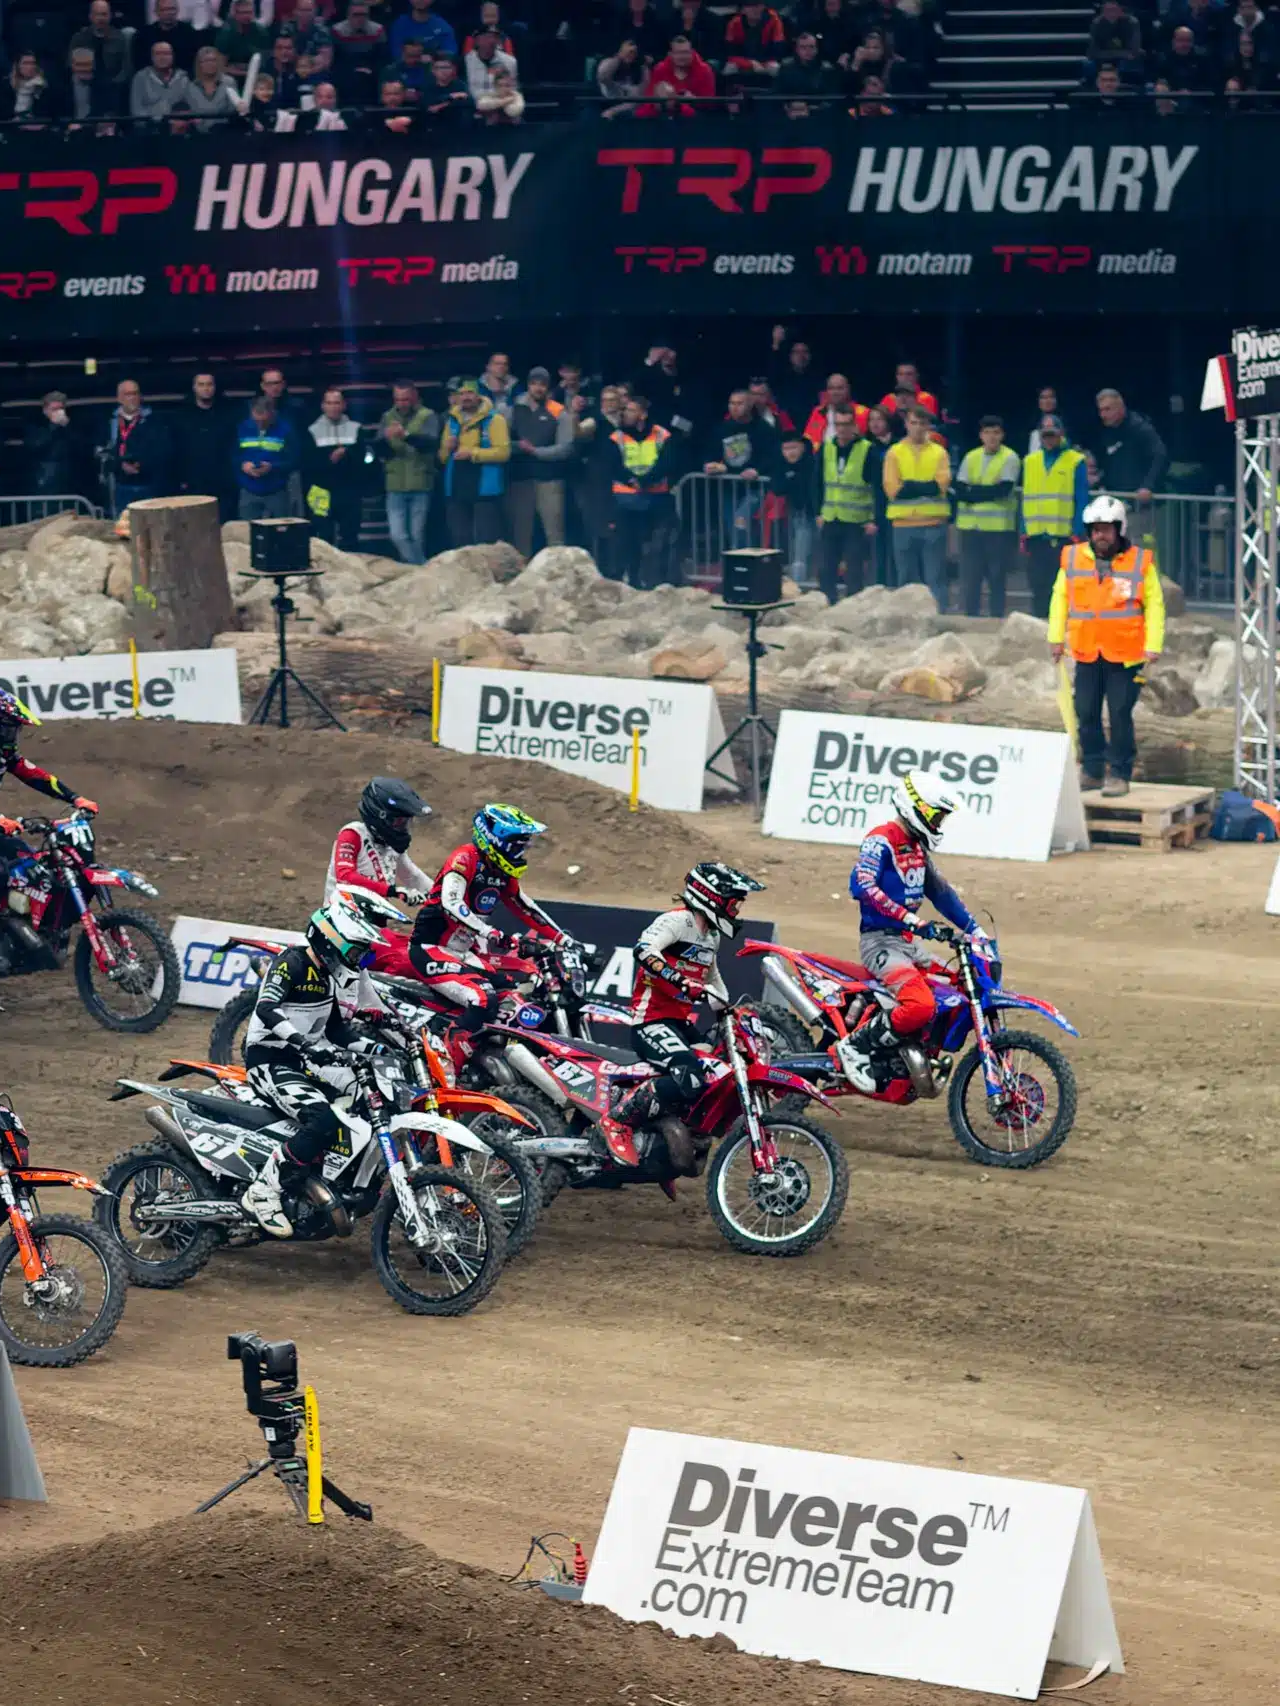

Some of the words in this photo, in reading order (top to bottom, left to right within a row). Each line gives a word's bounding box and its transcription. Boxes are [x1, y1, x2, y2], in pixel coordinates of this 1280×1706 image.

[194, 152, 534, 231] HUNGARY
[596, 147, 832, 214] TRP
[848, 145, 1198, 213] HUNGARY
[338, 257, 435, 287] TRP
[440, 255, 519, 284] media
[615, 246, 706, 274] TRP
[714, 252, 795, 276] events
[877, 251, 971, 276] motam
[992, 246, 1091, 274] TRP
[1097, 248, 1176, 275] media
[63, 274, 145, 298] events
[226, 266, 318, 293] motam
[1237, 380, 1266, 399] .com
[478, 685, 650, 737] Diverse
[648, 698, 673, 716] TM
[476, 726, 647, 766] ExtremeTeam
[814, 730, 999, 785] Diverse
[999, 745, 1024, 763] TM
[801, 802, 867, 828] .com
[552, 1059, 595, 1087] 67
[667, 1461, 969, 1566] Diverse
[968, 1502, 1010, 1532] TM
[655, 1527, 955, 1615] ExtremeTeam
[640, 1578, 747, 1624] .com
